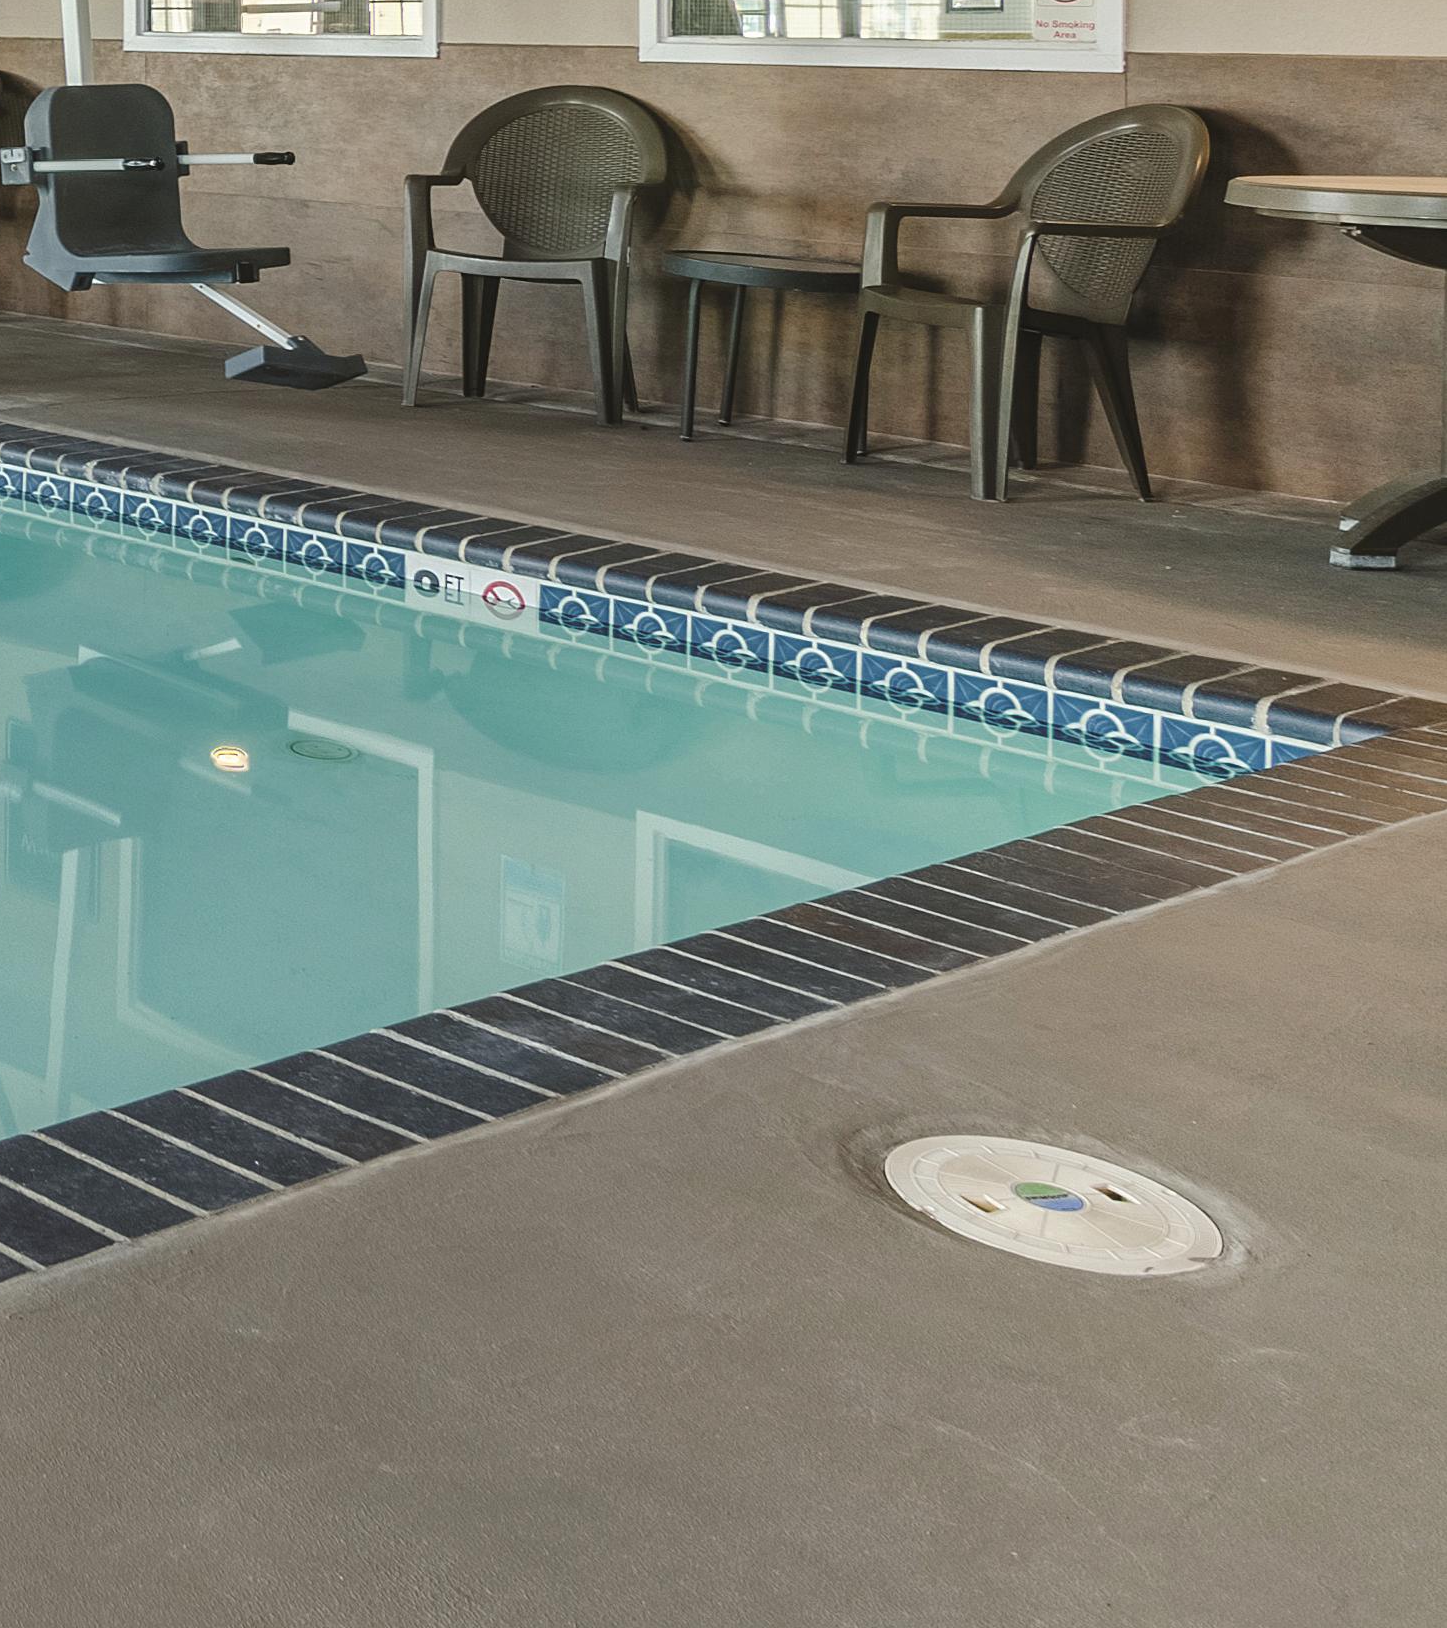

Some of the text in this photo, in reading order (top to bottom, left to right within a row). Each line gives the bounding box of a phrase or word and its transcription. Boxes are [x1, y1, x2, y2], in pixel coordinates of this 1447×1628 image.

[1036, 20, 1095, 30] No Smoking
[1053, 31, 1077, 39] Area
